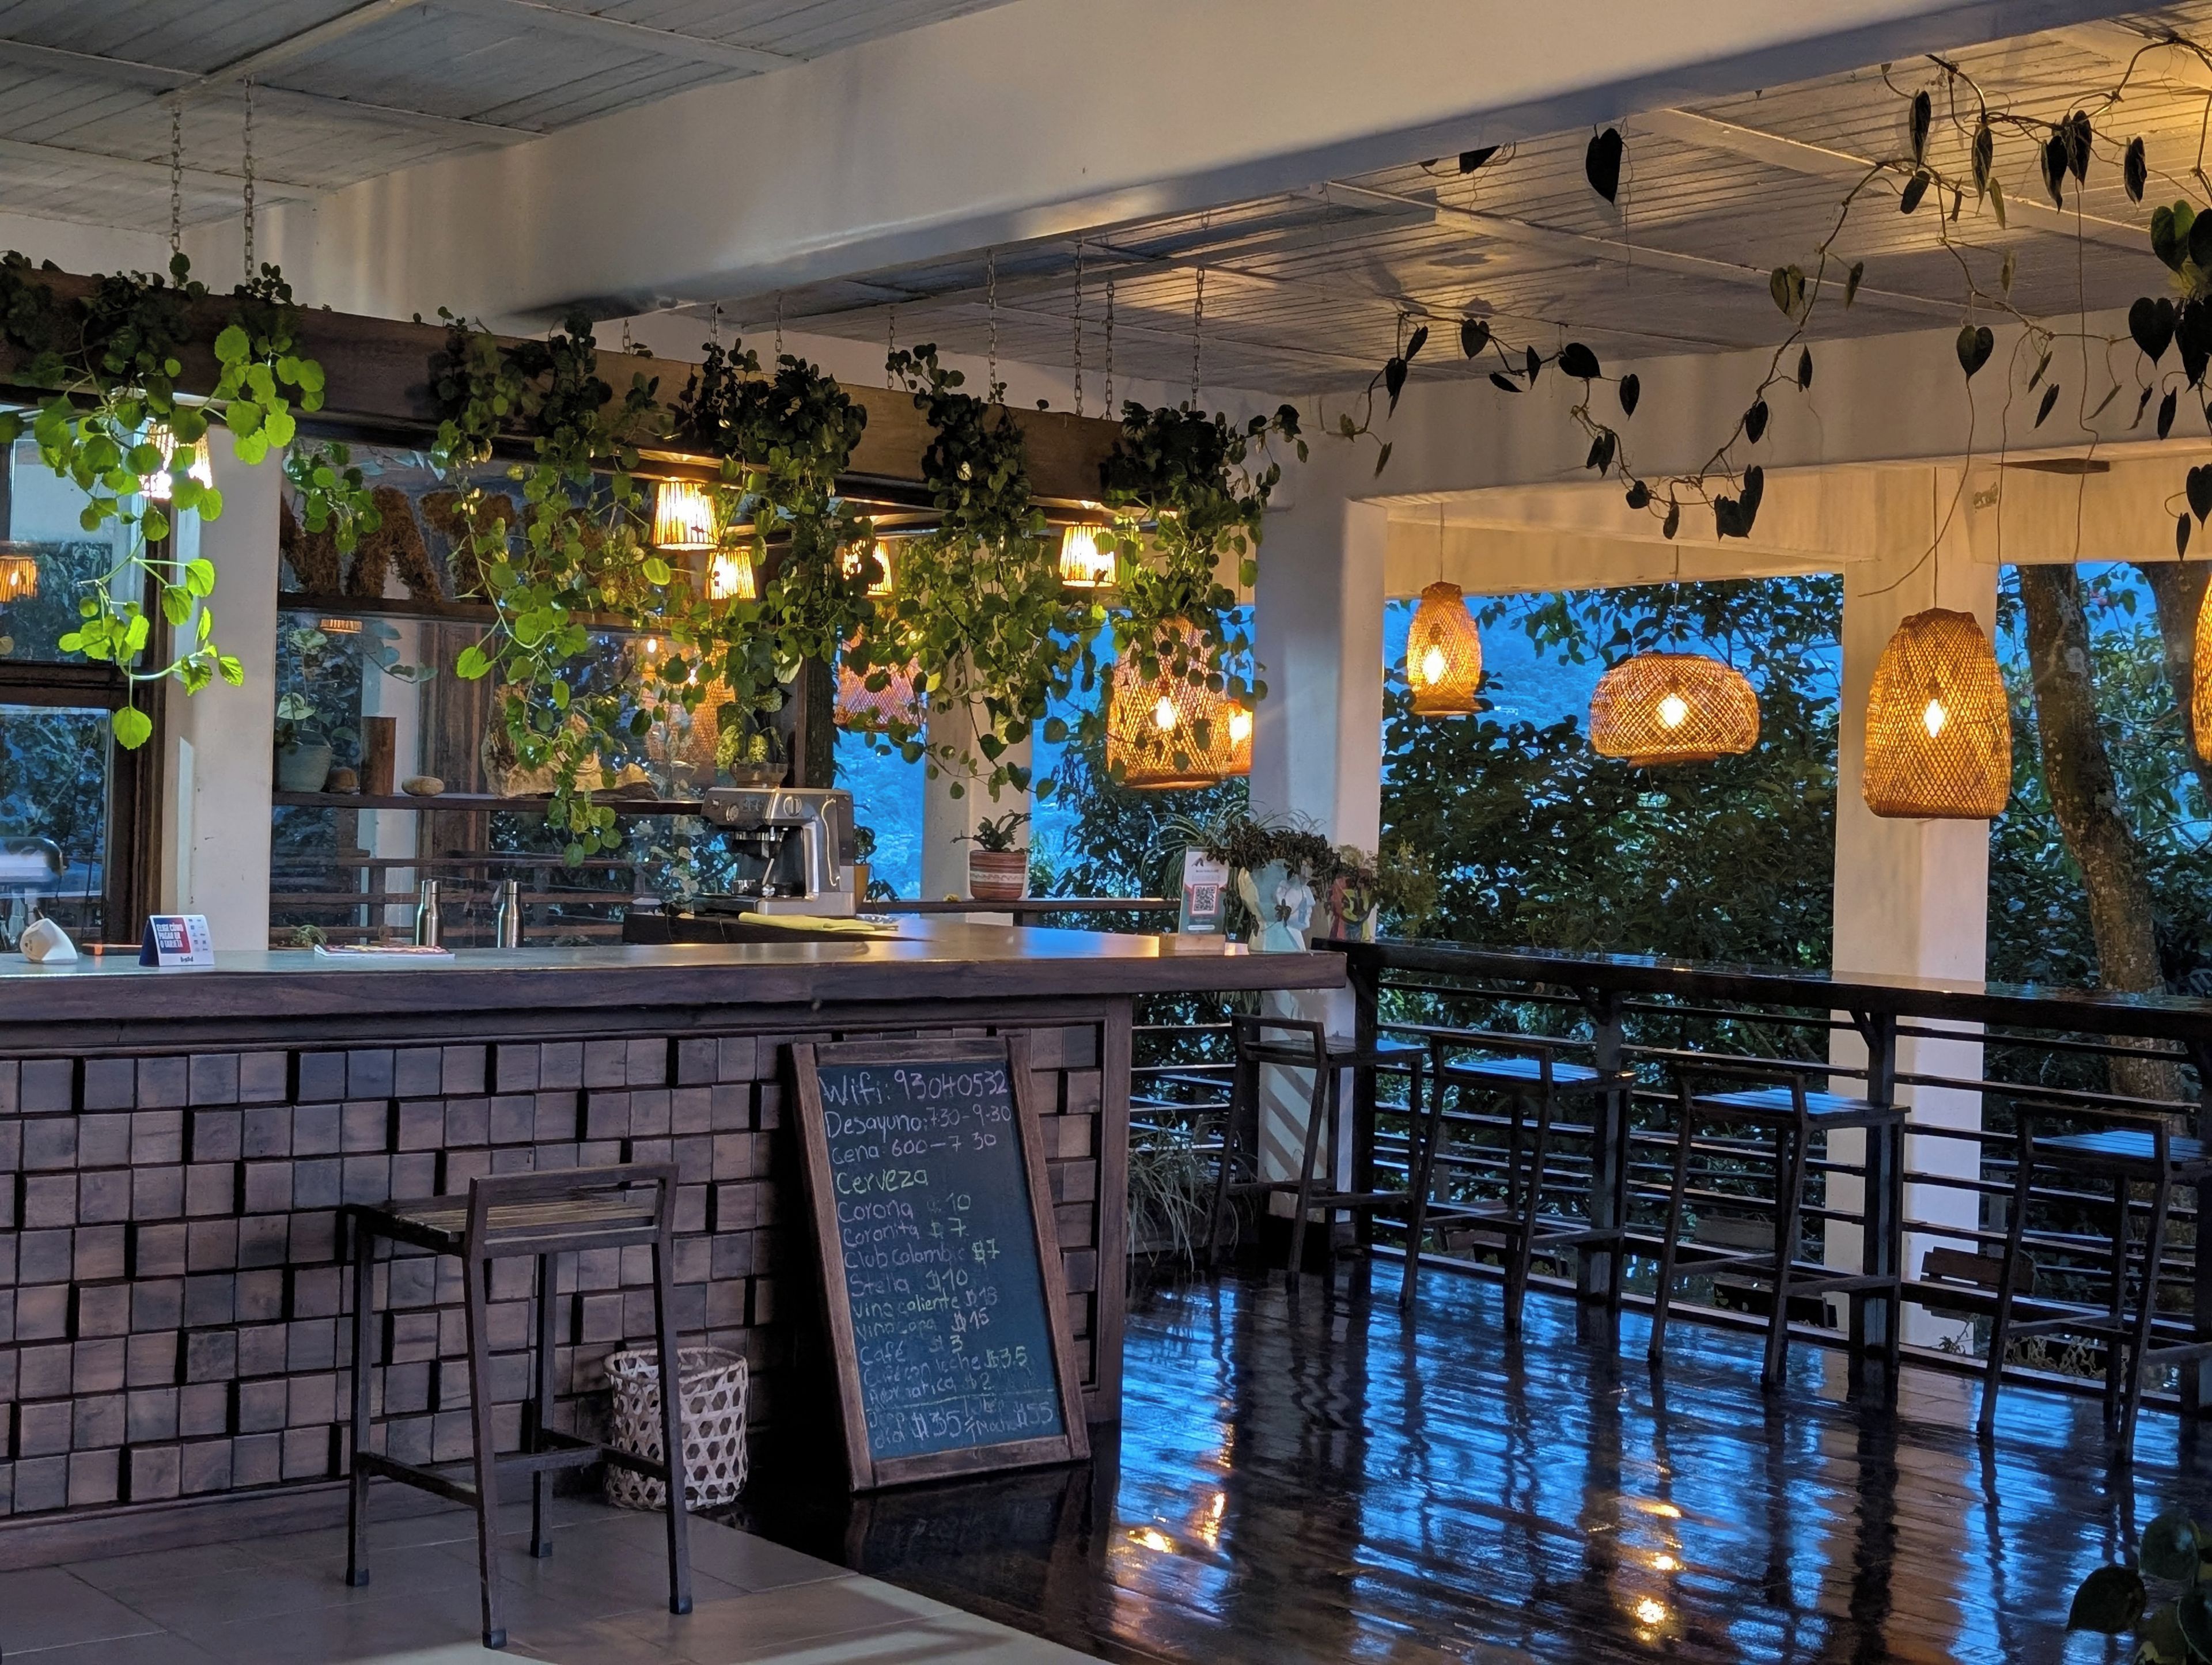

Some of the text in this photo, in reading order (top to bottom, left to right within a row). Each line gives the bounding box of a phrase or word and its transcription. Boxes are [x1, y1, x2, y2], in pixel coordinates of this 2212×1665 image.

[819, 1069, 1007, 1106] Wifi: 93040532
[837, 1169, 929, 1194] Cerveza
[838, 1200, 914, 1223] Corona
[843, 1220, 919, 1247] Coronita
[844, 1244, 888, 1267] Club
[850, 1270, 910, 1296] Stella
